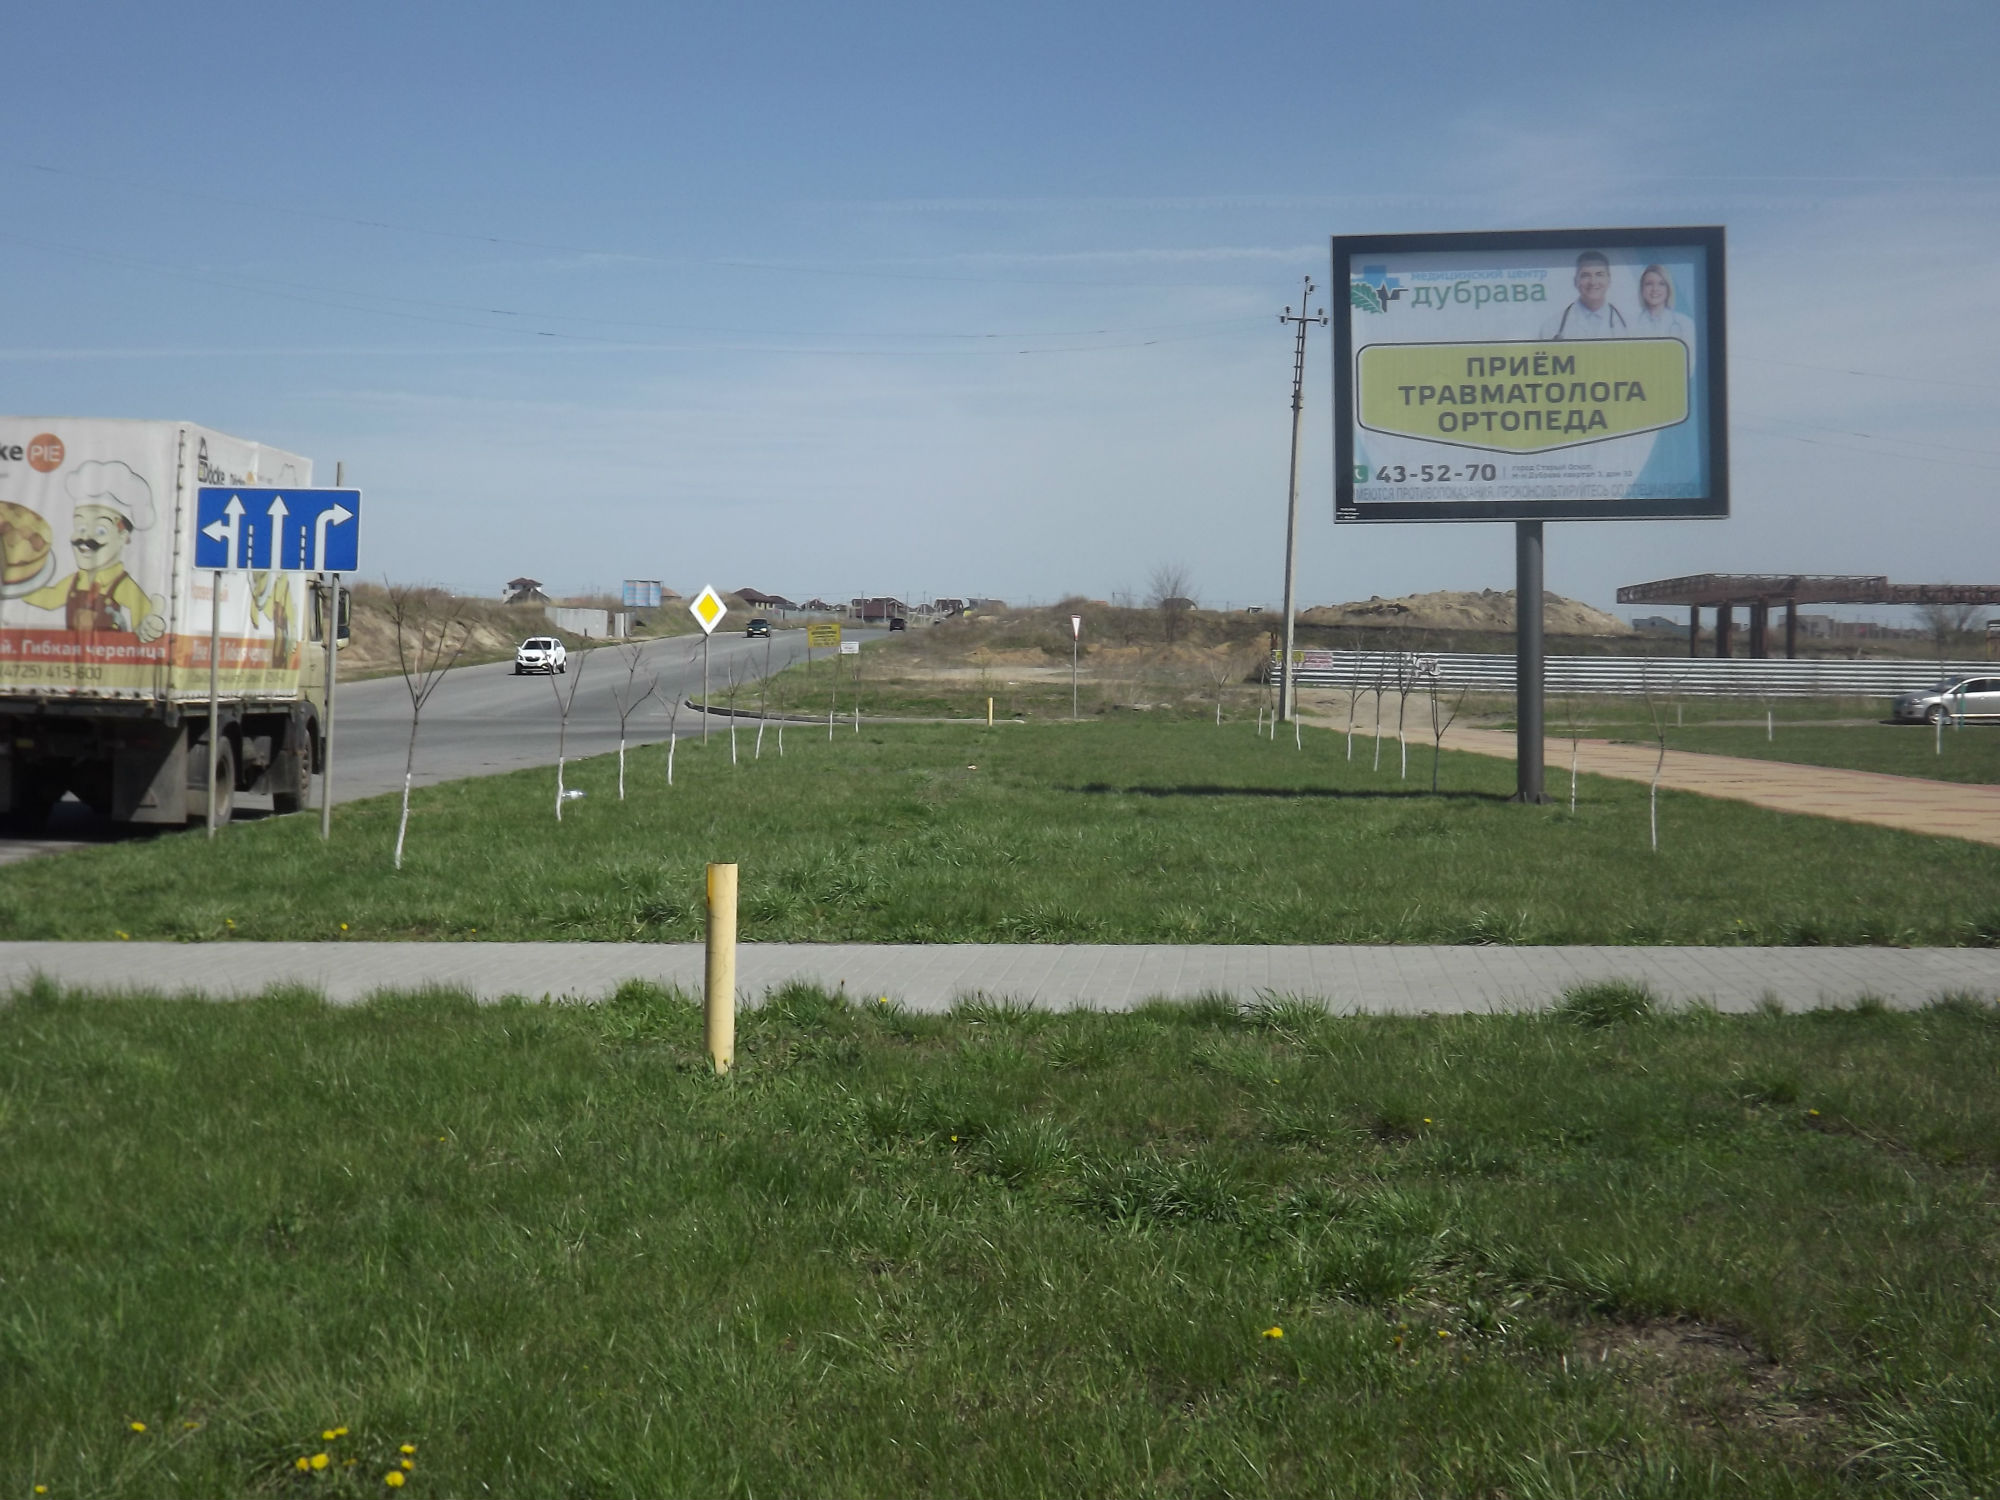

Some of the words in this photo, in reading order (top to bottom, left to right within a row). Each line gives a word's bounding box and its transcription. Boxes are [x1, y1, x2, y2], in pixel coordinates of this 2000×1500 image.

[1507, 269, 1548, 280] центр
[1411, 280, 1547, 310] дубрава
[1466, 352, 1576, 378] ПРИЁМ
[1398, 381, 1647, 406] ТРАВМАТОЛОГА
[1437, 409, 1609, 434] ОРТОПЕДА
[30, 445, 62, 462] PIE
[1376, 463, 1497, 484] 43-52-70
[22, 639, 82, 655] Гибкая
[86, 644, 166, 660] черепица
